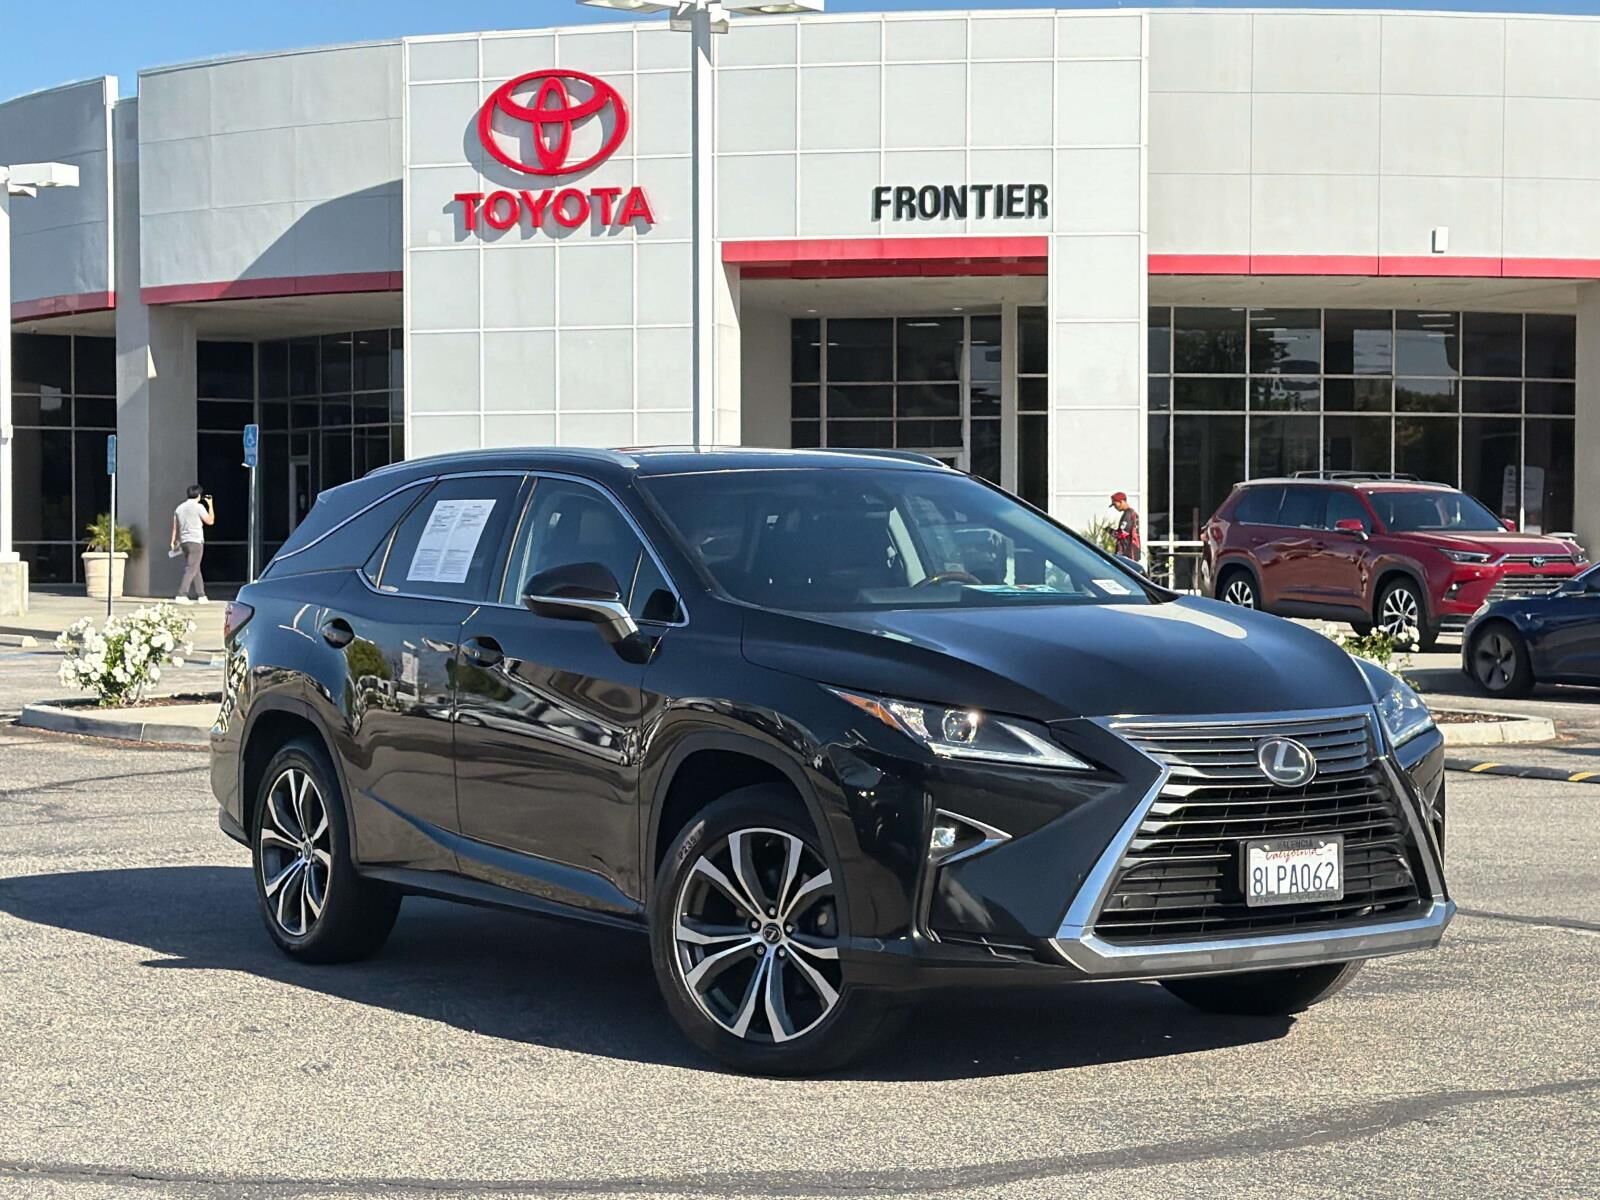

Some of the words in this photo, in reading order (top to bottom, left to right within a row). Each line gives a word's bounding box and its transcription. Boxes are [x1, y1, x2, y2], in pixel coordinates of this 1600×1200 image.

[454, 186, 657, 231] TOYOTA
[873, 183, 1048, 220] FRONTIER
[1253, 861, 1335, 895] 8LPA062
